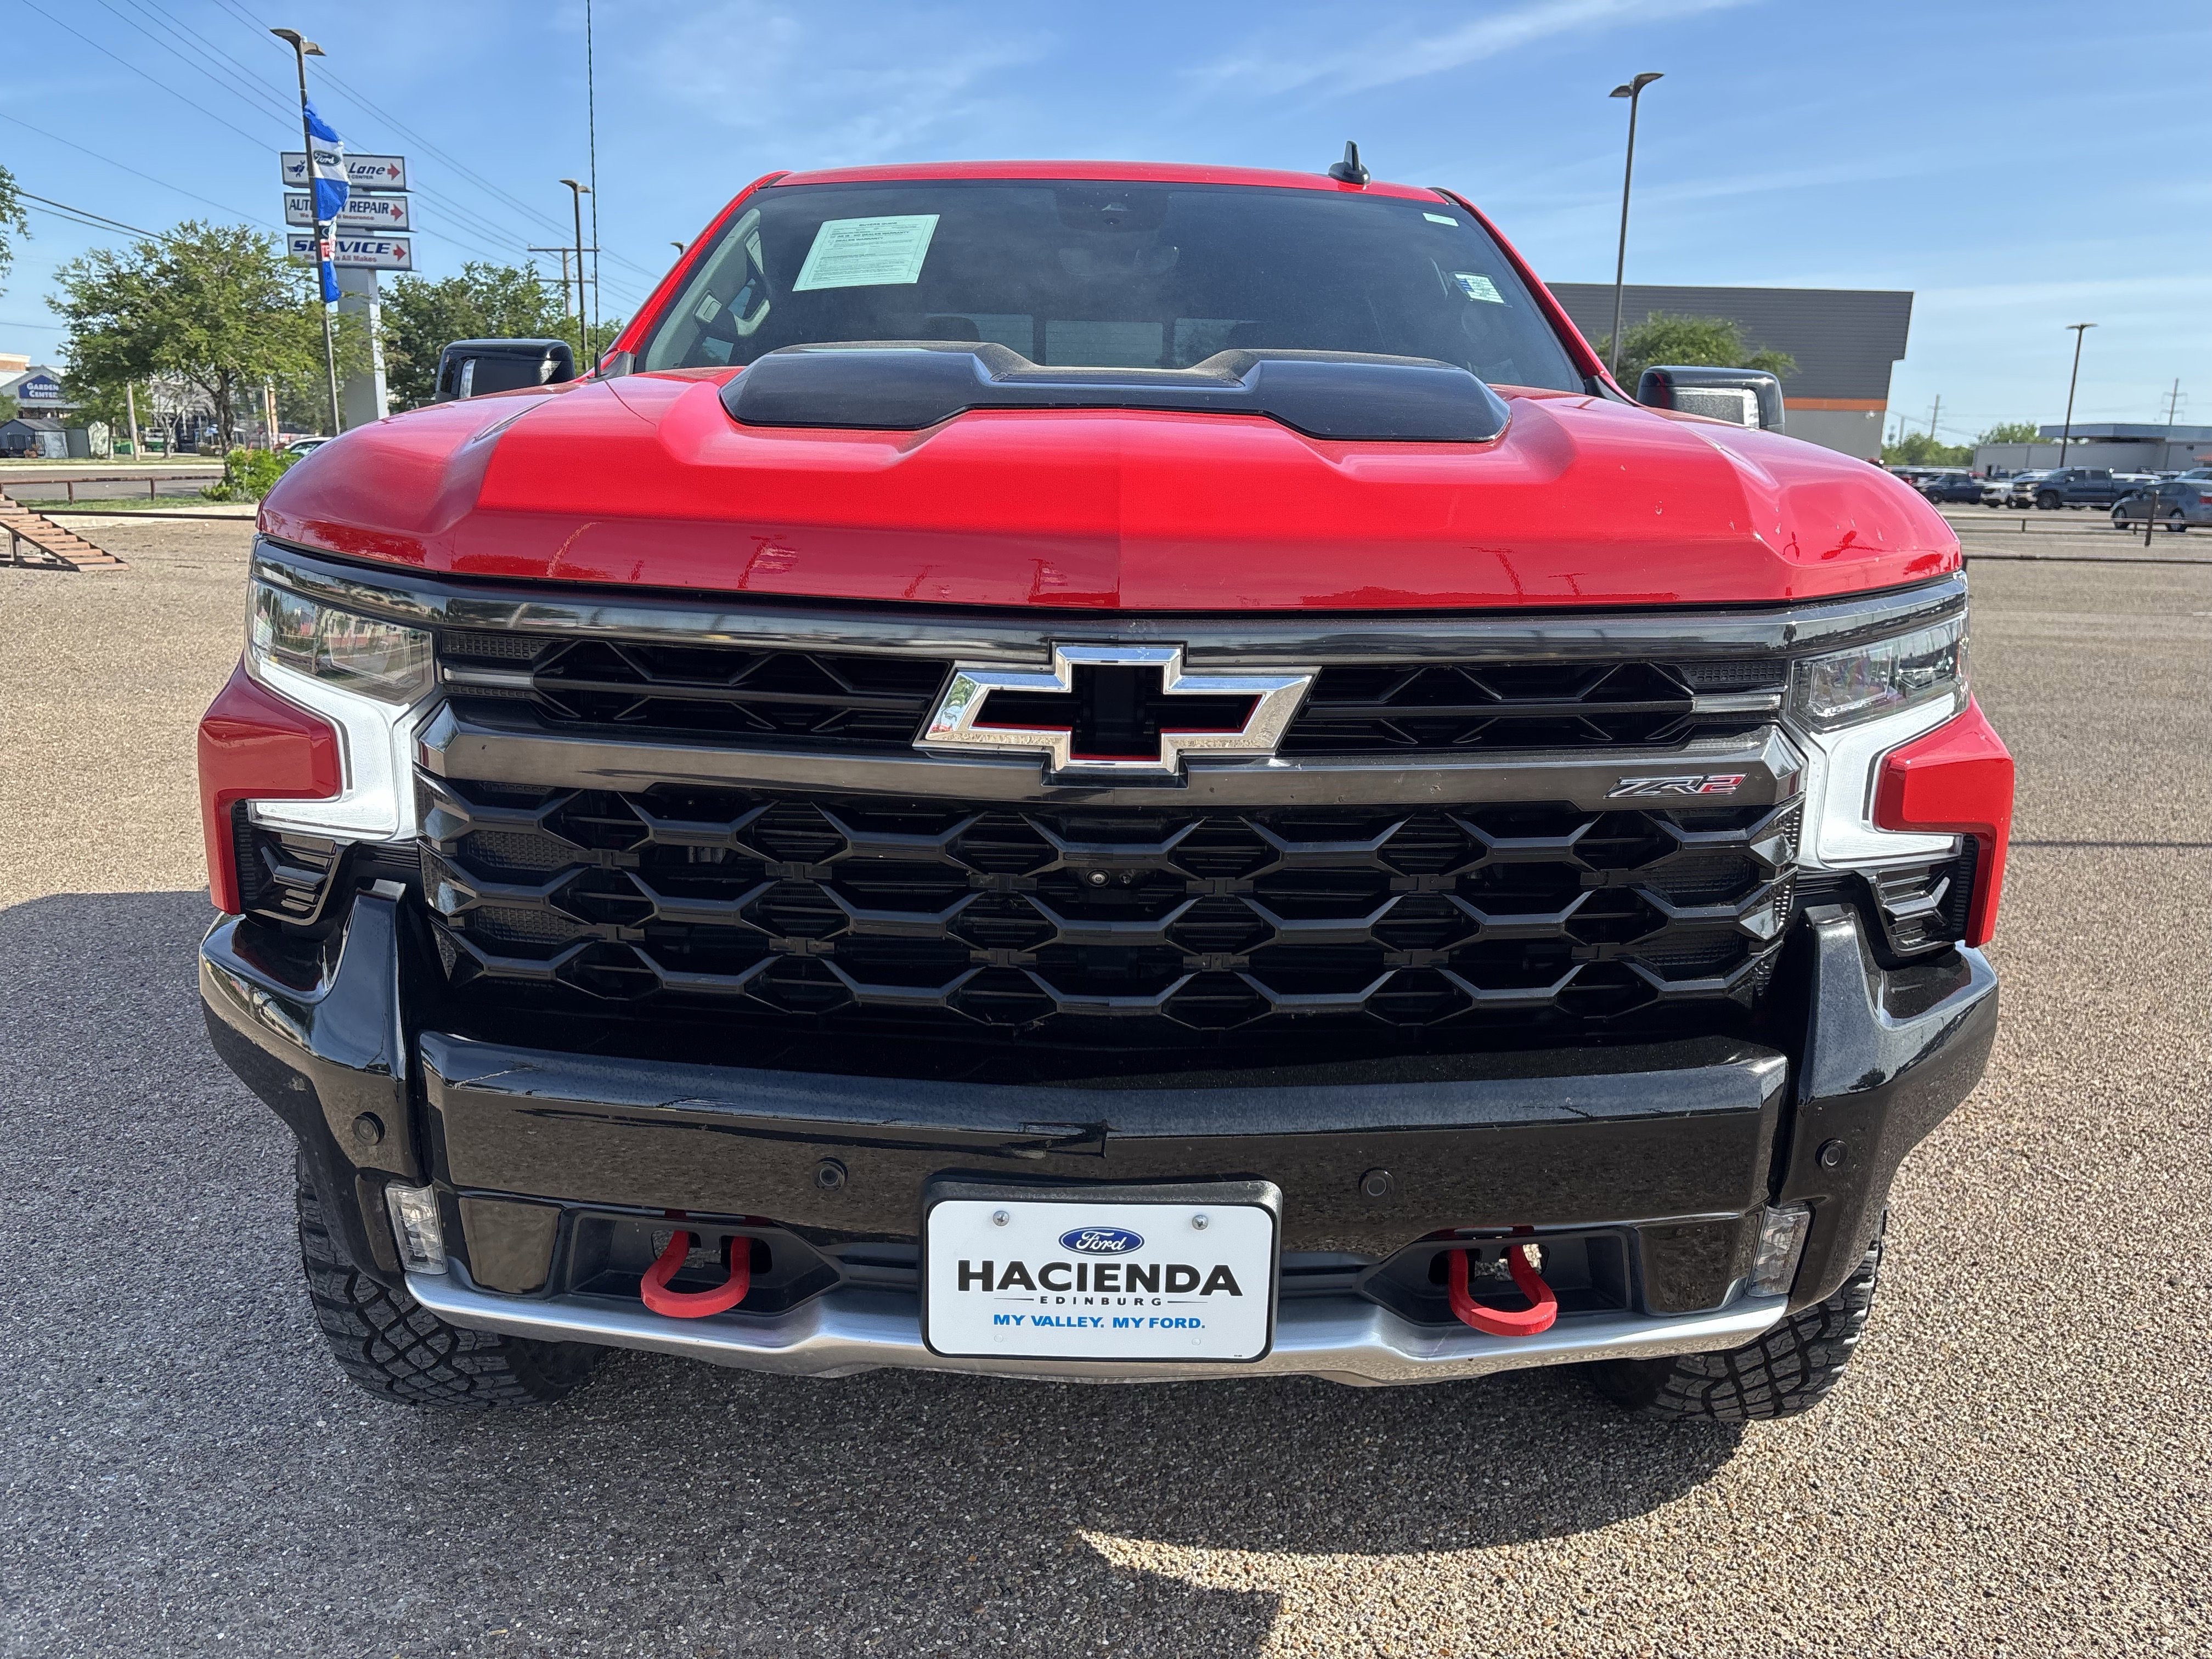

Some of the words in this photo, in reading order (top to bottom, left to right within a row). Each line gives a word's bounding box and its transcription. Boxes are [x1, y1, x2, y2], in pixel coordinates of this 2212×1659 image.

[313, 151, 335, 164] Ford
[348, 162, 385, 175] Lane
[289, 199, 311, 211] AUT
[349, 201, 390, 214] REPAIR
[292, 240, 392, 255] SEVICE
[1604, 772, 1750, 799] ZR2
[1076, 1231, 1127, 1251] Ford
[957, 1260, 1243, 1296] HACIENDA
[1040, 1296, 1162, 1307] EDINBURG
[994, 1314, 1025, 1326] MY
[1031, 1315, 1104, 1328] VALLEY.
[1113, 1317, 1148, 1328] MY
[1149, 1318, 1206, 1329] FORD.
